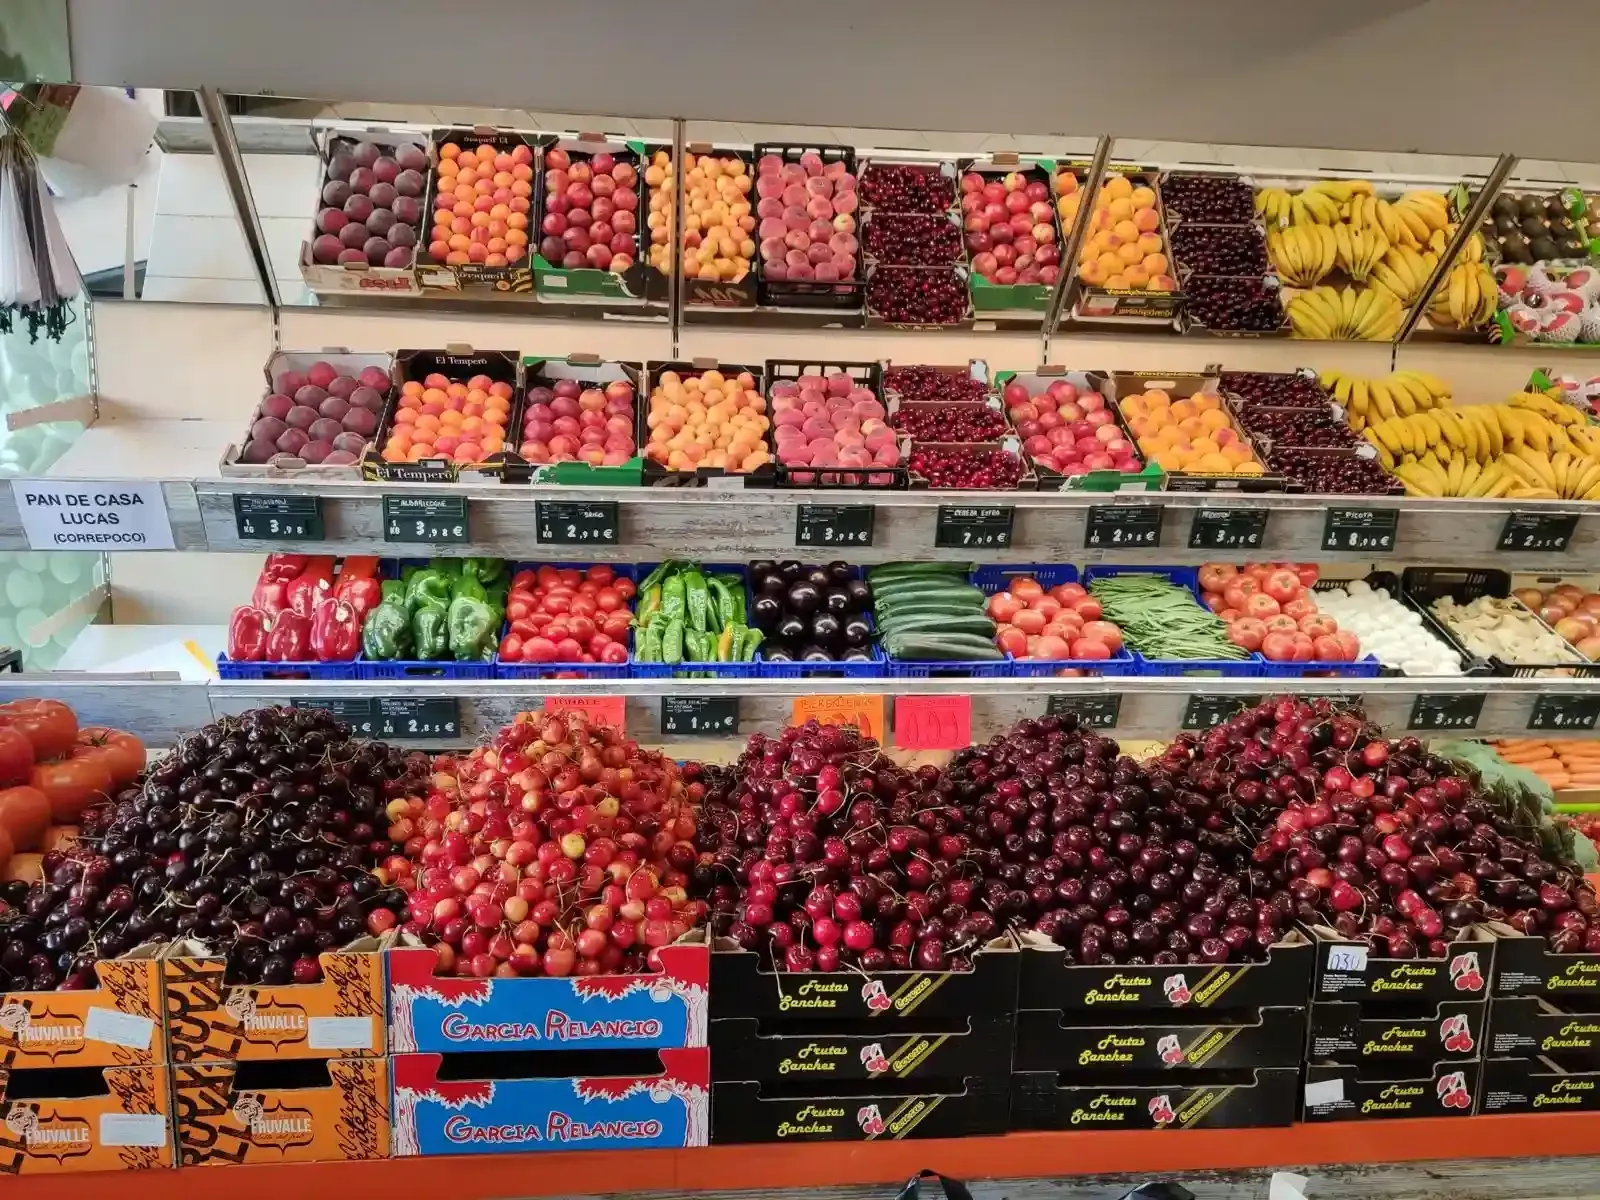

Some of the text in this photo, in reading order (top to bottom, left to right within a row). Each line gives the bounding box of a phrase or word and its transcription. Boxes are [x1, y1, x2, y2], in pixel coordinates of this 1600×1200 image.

[435, 356, 446, 365] El
[376, 467, 390, 478] El
[25, 493, 144, 506] PAN DE CASA
[60, 512, 120, 525] LUCAS
[53, 532, 146, 544] (CORREPOCO)
[1391, 964, 1437, 978] Frutas
[1566, 961, 1600, 975] Frut
[798, 980, 849, 994] Frutas
[1104, 975, 1152, 988] Frutas
[1371, 979, 1424, 993] Sanchez
[1547, 976, 1597, 989] Sanchez
[779, 995, 836, 1011] Sanchez
[1084, 989, 1140, 1005] Sanchez
[441, 1008, 662, 1041] GARCIA RELANCIO
[1560, 1021, 1600, 1036] Fruta
[1382, 1027, 1427, 1040] Frutas
[1097, 1035, 1146, 1049] Frutas
[1362, 1041, 1414, 1055] Sanchez
[1541, 1036, 1591, 1050] Sanchez
[798, 1043, 848, 1057] Frutas
[1078, 1050, 1134, 1065] Sanchez
[778, 1058, 836, 1074] Sanchez
[1379, 1085, 1424, 1099] Frutas
[1551, 1079, 1595, 1091] Frutas
[1089, 1094, 1137, 1109] Frutas
[1361, 1099, 1412, 1113] Sanchez
[1533, 1094, 1582, 1107] Sanchez
[795, 1105, 845, 1121] Frutas
[1070, 1110, 1125, 1125] Sanchez
[444, 1110, 664, 1144] GARCIA RELANCIO
[776, 1121, 833, 1137] Sanchez
